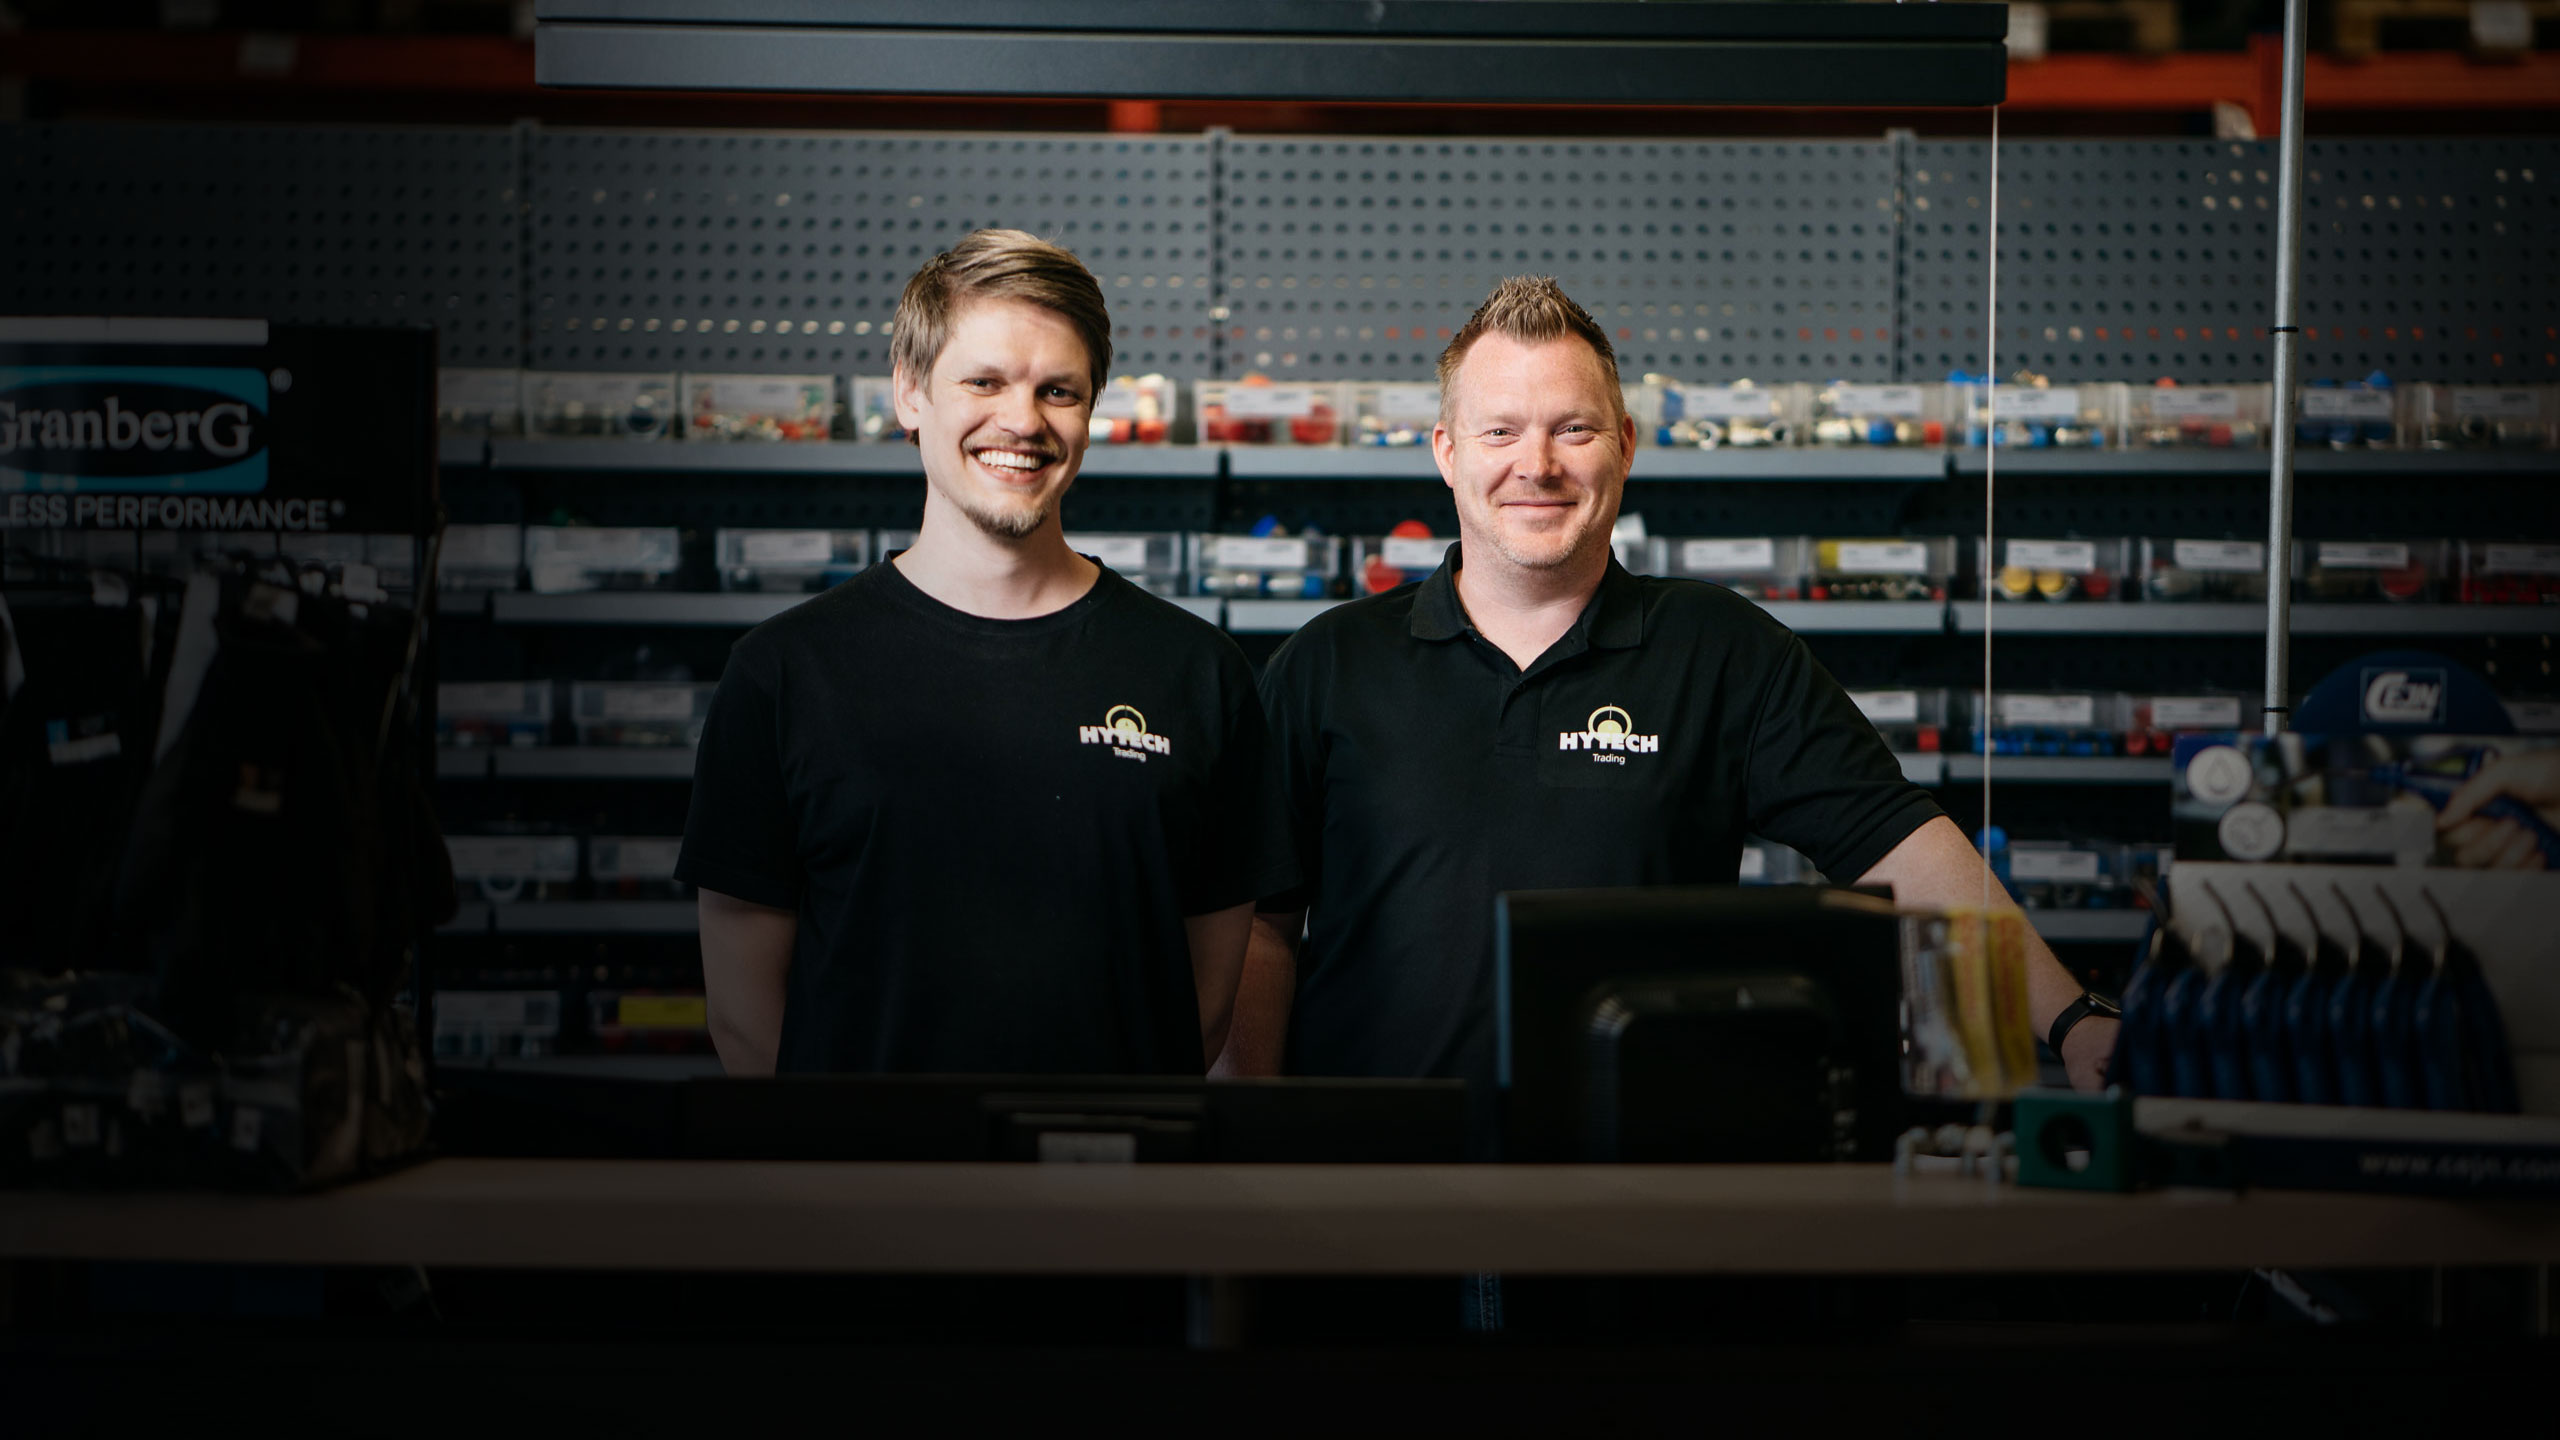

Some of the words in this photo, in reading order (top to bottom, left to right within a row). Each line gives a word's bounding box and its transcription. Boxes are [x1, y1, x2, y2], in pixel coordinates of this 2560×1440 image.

[75, 494, 330, 531] PERFORMANCE
[1079, 725, 1171, 756] HYTECH
[1559, 731, 1659, 754] HYTECH
[1112, 746, 1147, 763] Trading
[1592, 753, 1626, 765] Trading
